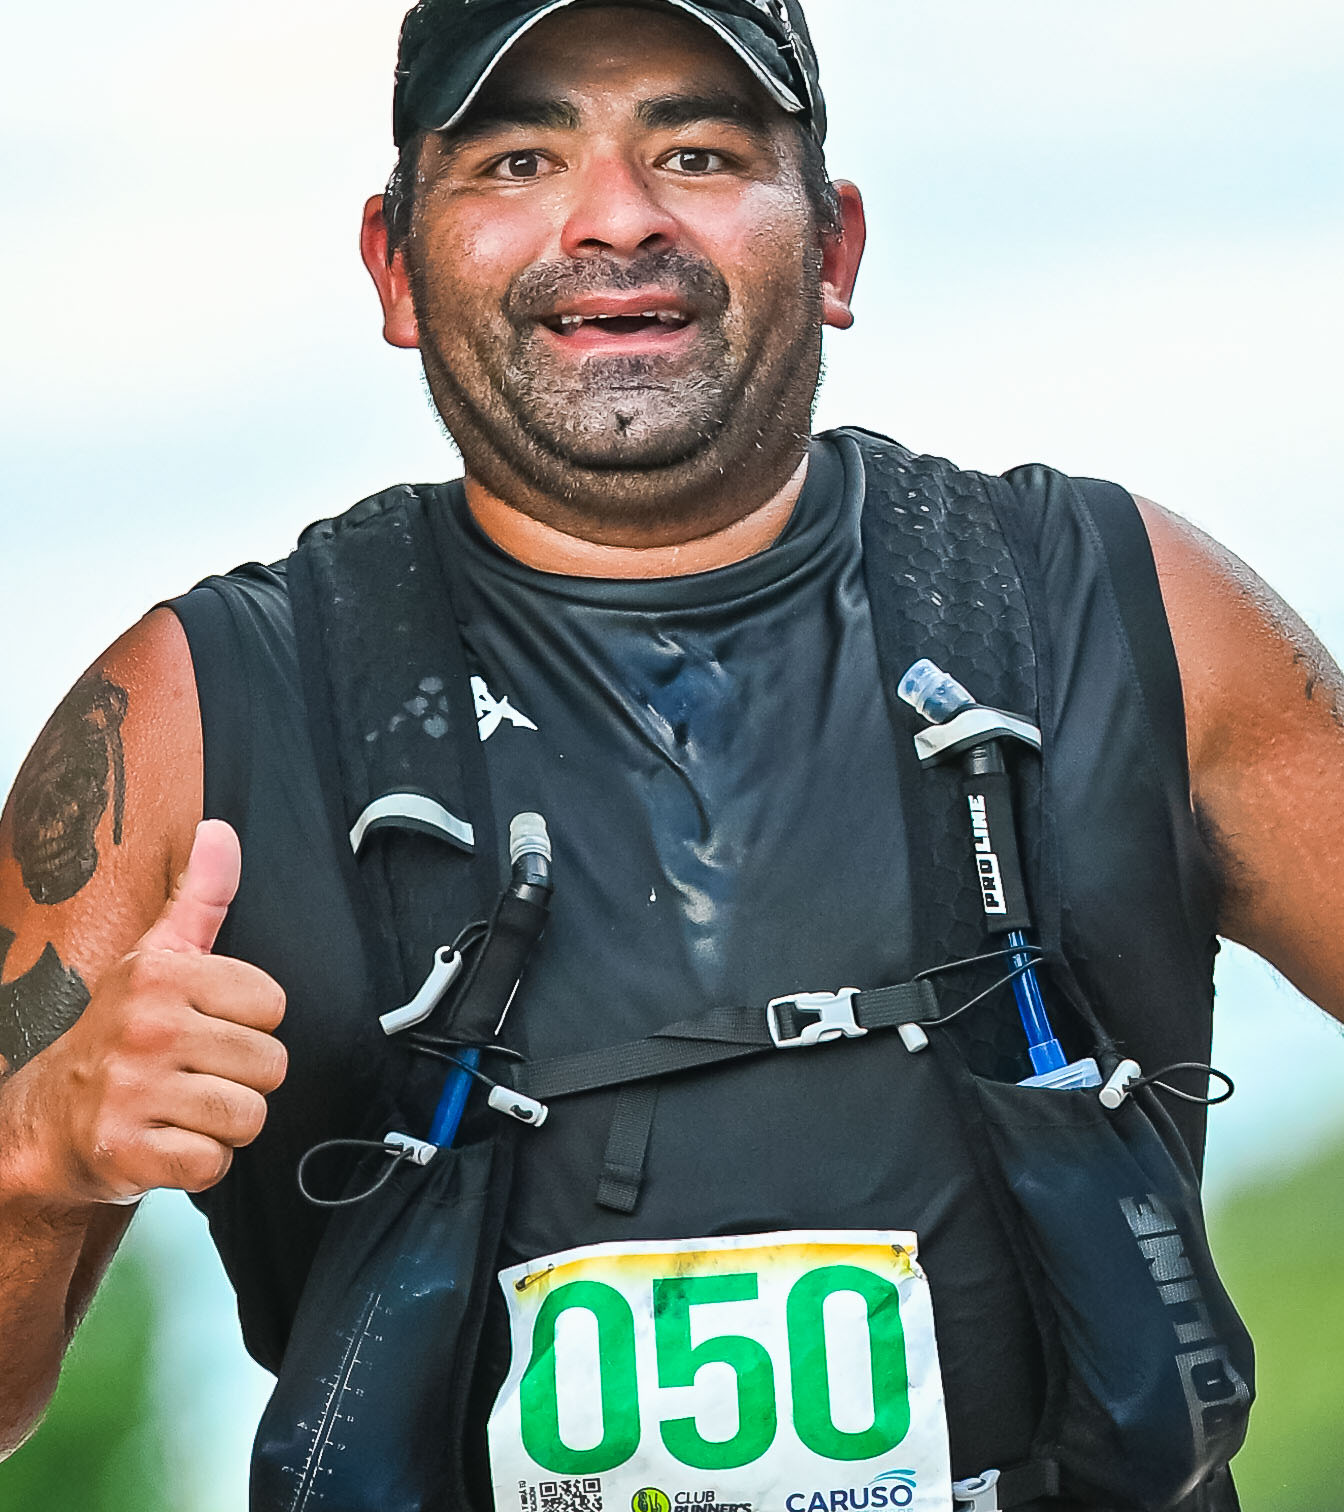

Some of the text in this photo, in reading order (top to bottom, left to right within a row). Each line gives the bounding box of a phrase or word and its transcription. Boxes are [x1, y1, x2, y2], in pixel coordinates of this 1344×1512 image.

[967, 794, 991, 852] LINE
[519, 1264, 911, 1475] 050
[674, 1490, 715, 1504] CLUB
